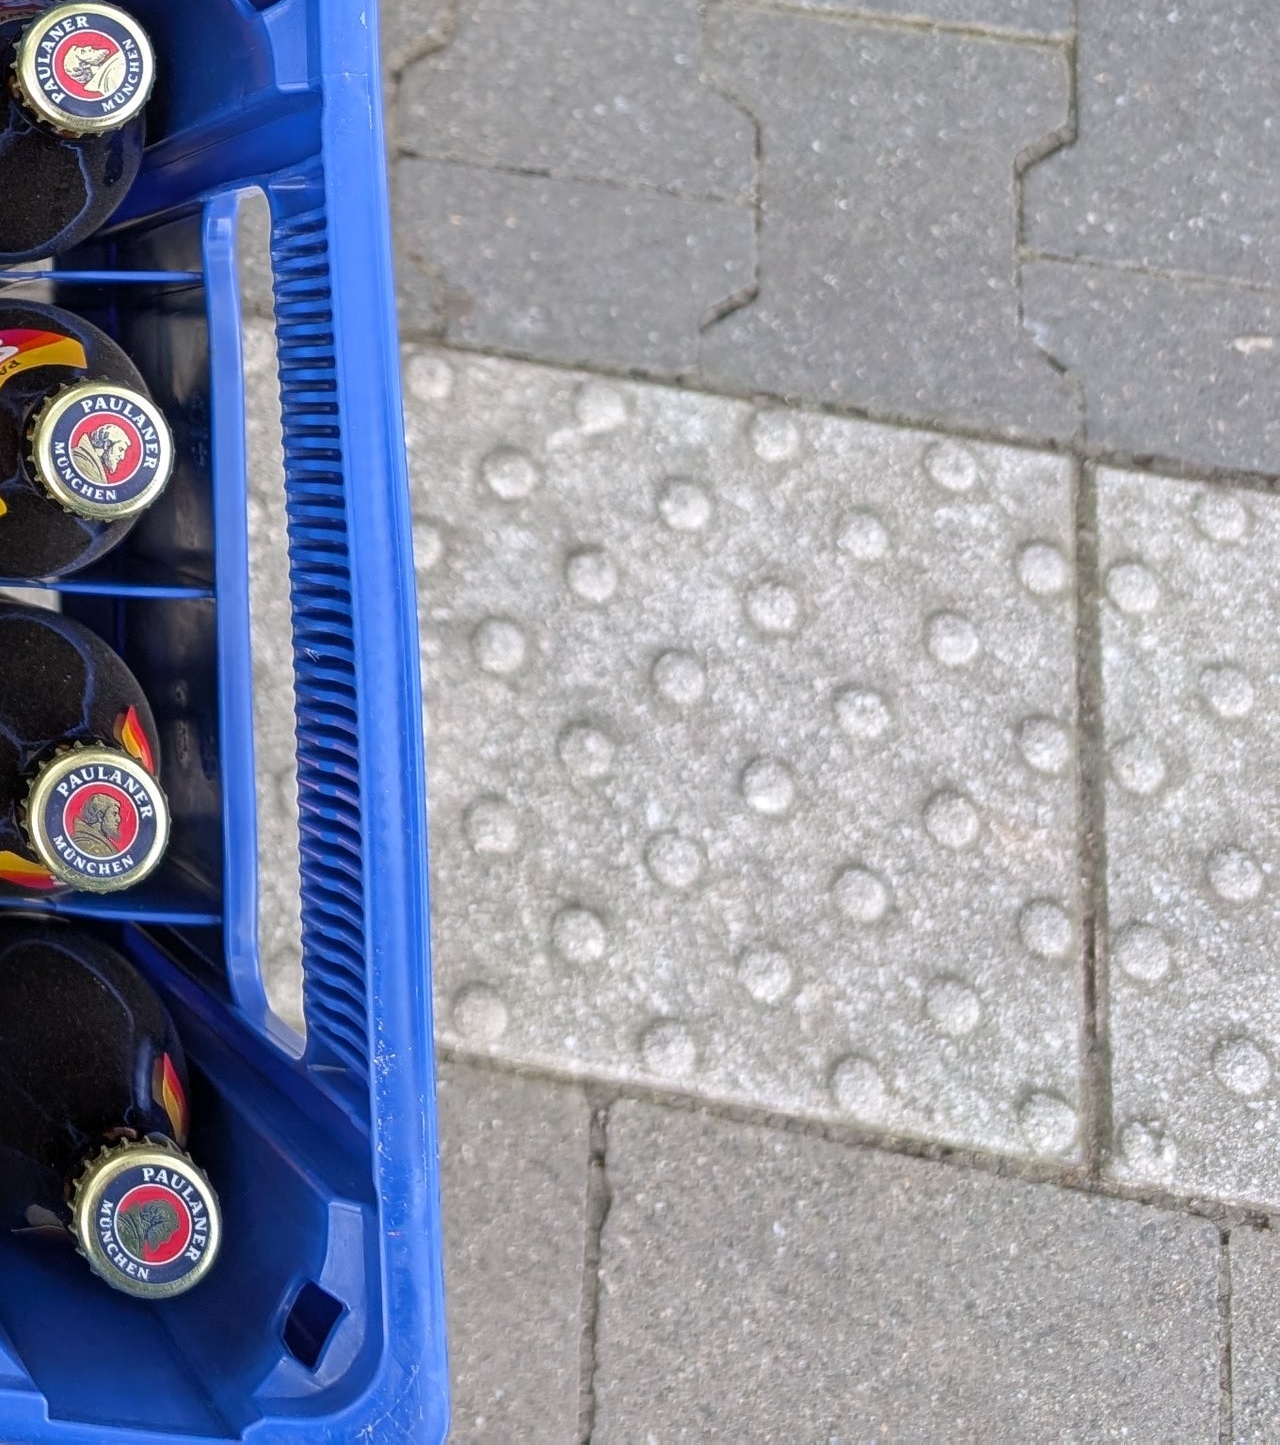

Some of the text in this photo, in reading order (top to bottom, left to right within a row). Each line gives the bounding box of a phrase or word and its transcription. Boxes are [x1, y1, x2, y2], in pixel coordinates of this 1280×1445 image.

[36, 15, 90, 105] PAULANER
[100, 38, 141, 113] MÜNCHEN
[79, 396, 160, 470] PAULANER
[54, 441, 117, 501] MÜNCHEN
[55, 765, 154, 820] PAULANER
[47, 834, 135, 876] MÜNCHEN
[99, 1198, 150, 1281] MÜNCHEN
[141, 1167, 208, 1262] PAULANER
